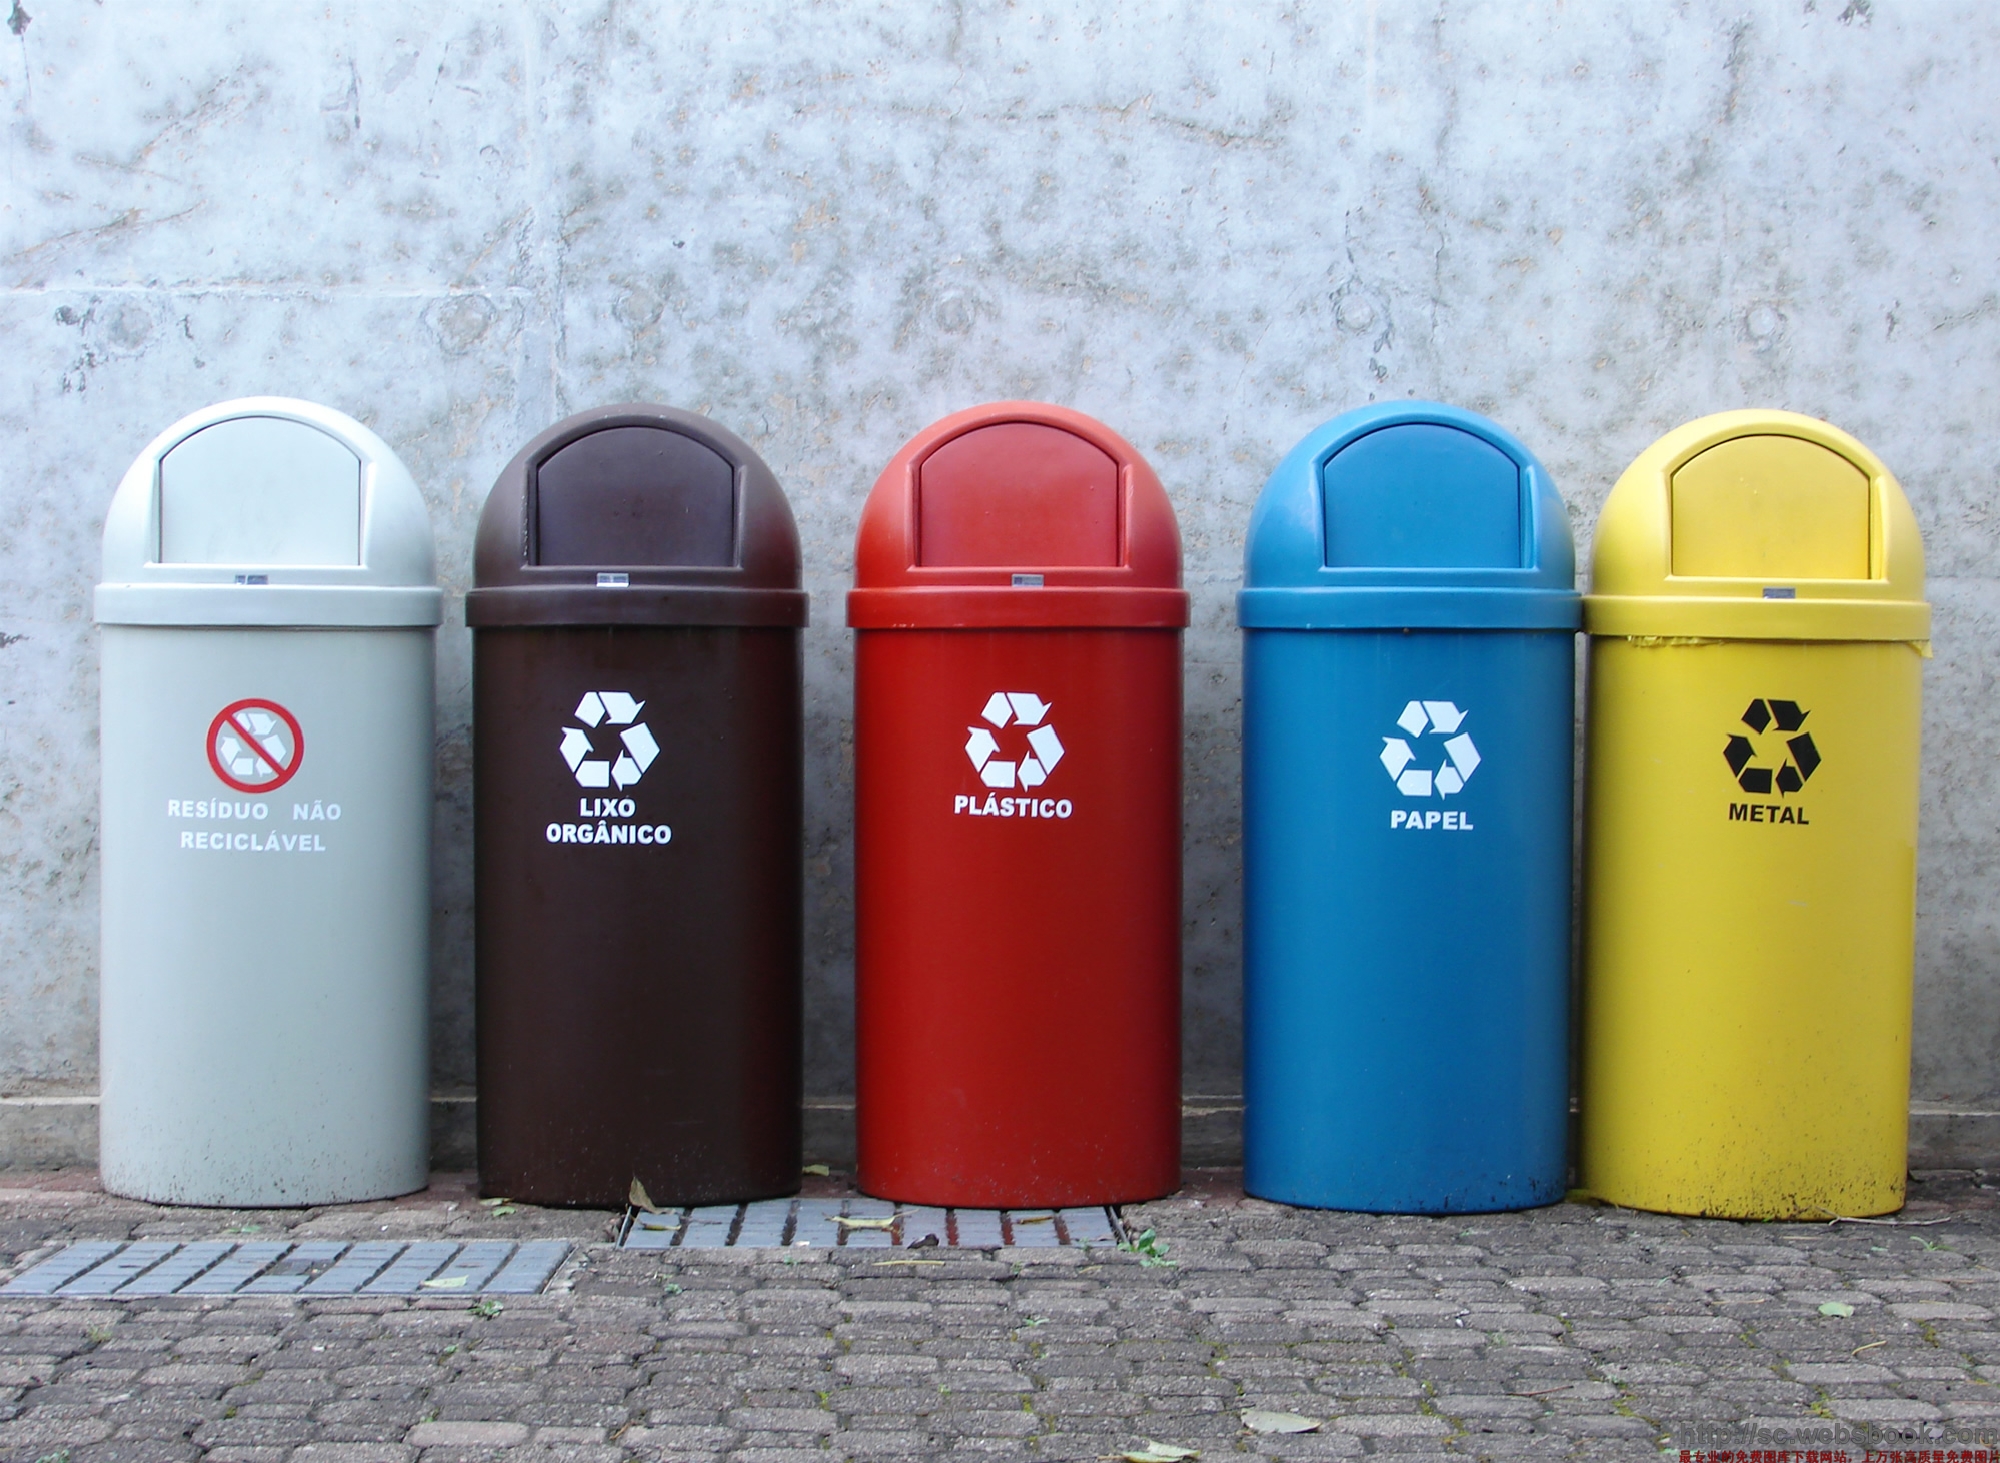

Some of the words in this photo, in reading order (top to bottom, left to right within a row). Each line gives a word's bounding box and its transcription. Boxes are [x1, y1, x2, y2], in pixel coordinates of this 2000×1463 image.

[168, 798, 269, 821] RESÍDUO
[293, 799, 342, 821] NÃO
[580, 798, 635, 817] LIXO
[954, 793, 1073, 818] PLÁSTICO
[1729, 803, 1809, 825] METAL
[1391, 810, 1473, 830] PAPEL
[181, 829, 325, 851] RECICLÁVEL
[546, 820, 672, 844] ORGÂNICO
